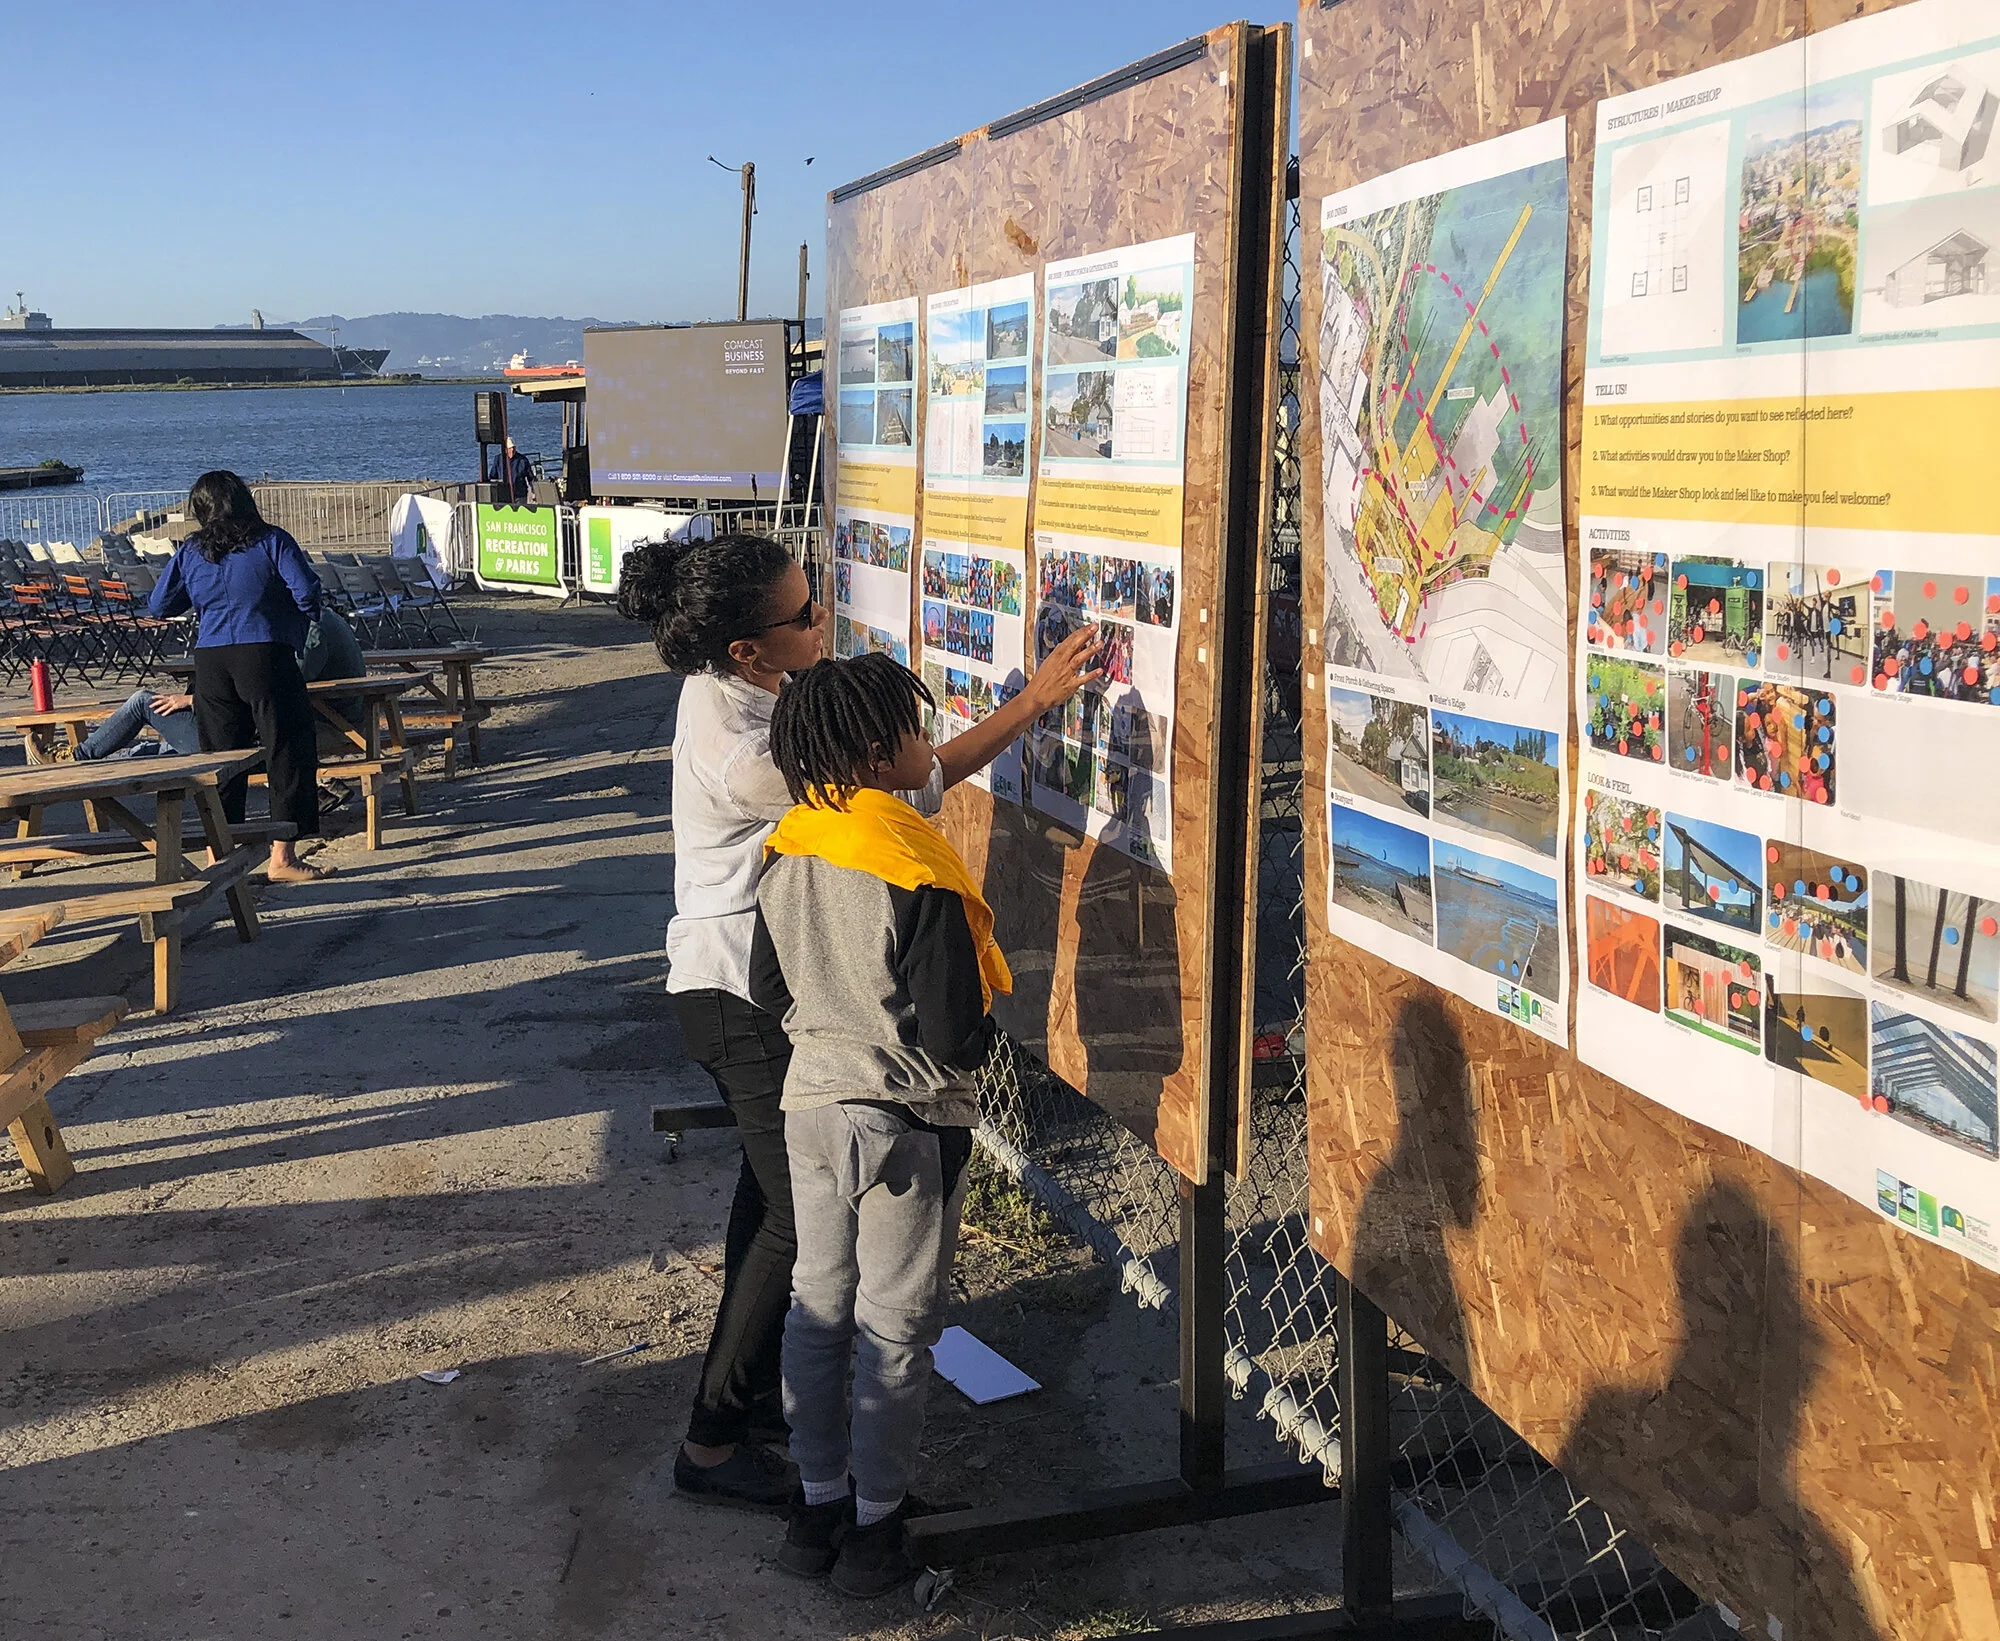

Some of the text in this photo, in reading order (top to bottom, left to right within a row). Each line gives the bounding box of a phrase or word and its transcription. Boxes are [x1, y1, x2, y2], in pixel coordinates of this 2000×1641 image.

[1607, 106, 1659, 130] STRUCTURES
[1666, 95, 1697, 114] MAKER
[1697, 87, 1722, 105] SHOP
[724, 339, 763, 350] COMCAST
[725, 350, 765, 361] BUSINESS
[1596, 384, 1628, 396] TELL US!
[1600, 415, 1618, 425] What
[1619, 412, 1669, 428] opportunities
[1670, 412, 1685, 424] and
[1686, 412, 1714, 424] stories
[1715, 411, 1726, 422] do
[1726, 413, 1740, 426] you
[1740, 410, 1758, 422] want
[1760, 410, 1768, 421] to
[1769, 411, 1784, 421] see
[1785, 407, 1825, 420] reflected
[1827, 406, 1854, 420] here?
[1600, 450, 1619, 461] What
[1619, 450, 1650, 461] activities
[1651, 450, 1675, 461] would
[1676, 450, 1697, 461] draw
[1698, 452, 1714, 464] you
[1715, 450, 1723, 461] to
[1724, 450, 1736, 461] the
[1737, 450, 1762, 462] Maker
[1763, 449, 1790, 465] Shop?
[1598, 485, 1617, 497] What
[1617, 486, 1639, 497] would
[1640, 486, 1651, 498] the
[1652, 487, 1678, 499] Maker
[1679, 487, 1701, 503] Shop
[1702, 488, 1720, 500] look
[1721, 488, 1734, 500] and
[1735, 488, 1749, 501] feel
[1750, 489, 1766, 501] like
[1767, 490, 1776, 502] to
[1778, 489, 1803, 503] make
[1803, 493, 1821, 507] you
[1822, 490, 1838, 504] feel
[1840, 491, 1892, 506] welcome?
[486, 521, 547, 536] SAN FRANCISCO
[1589, 529, 1630, 541] ACTIVITIES
[485, 538, 548, 557] RECREATION
[505, 558, 540, 575] PARKS
[1870, 689, 1913, 703] Community Stage
[1452, 698, 1466, 711] Edge
[1587, 772, 1632, 795] LOOK & FEEL
